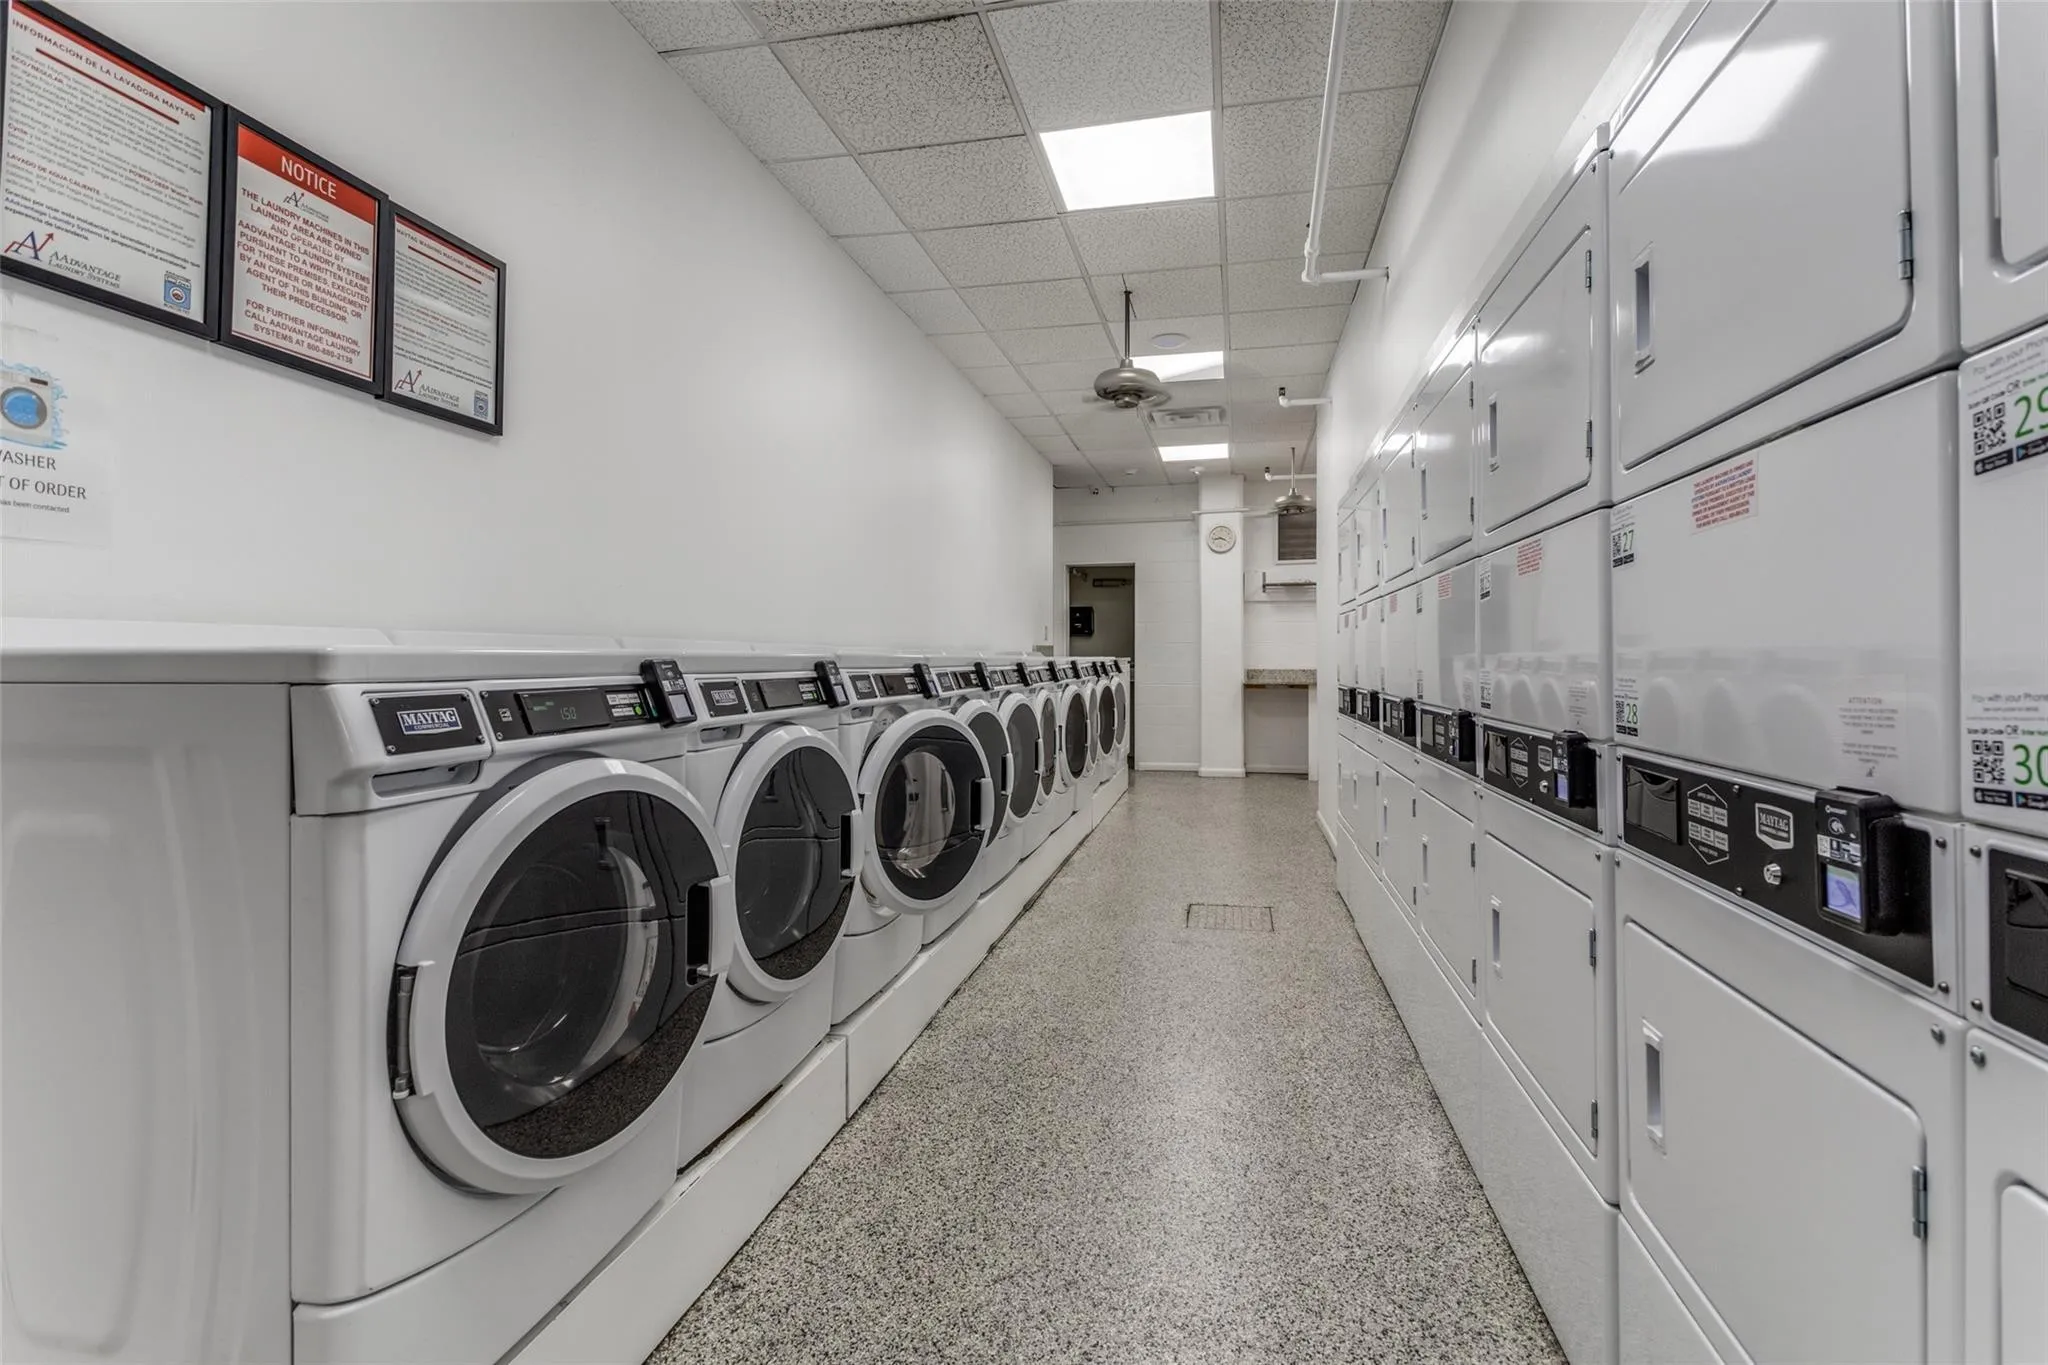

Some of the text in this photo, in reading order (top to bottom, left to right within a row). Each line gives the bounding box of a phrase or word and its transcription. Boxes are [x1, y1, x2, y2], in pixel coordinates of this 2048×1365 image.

[85, 57, 96, 68] DE
[100, 65, 110, 76] LA
[114, 72, 159, 101] LAVADORA
[162, 97, 195, 120] MAYTAG
[281, 154, 336, 200] NOTICE
[241, 187, 258, 203] THE
[261, 196, 300, 222] LAUNDRY
[302, 216, 342, 242] MACHINES
[344, 236, 351, 246] IN
[353, 240, 369, 255] THIS
[251, 203, 290, 228] LAUNDRY
[292, 223, 314, 239] AREA
[316, 234, 332, 248] ARE
[334, 242, 361, 261] OWNED
[238, 218, 369, 284] AADVANTAGE LAUNDRY SYSTEMS
[240, 230, 367, 293] PURSUANT TO A WRITTEN LEASE
[270, 223, 343, 263] AND OPERATED BY
[237, 240, 254, 254] FOR
[258, 249, 284, 267] THESE
[331, 280, 369, 303] EXECUTED
[239, 252, 367, 312] BY AN OWNER OR MANAGEMENT
[262, 283, 286, 299] THEIR
[246, 266, 275, 284] AGENT
[278, 279, 288, 289] OF
[292, 284, 309, 298] THIS
[351, 308, 361, 319] OR
[246, 298, 263, 312] FOR
[266, 305, 304, 327] FURTHER
[244, 309, 360, 357] CALL AADVANTAGE LAUNDRY
[254, 323, 292, 343] SYSTEMS
[295, 337, 304, 347] AT
[9, 477, 30, 491] OF
[34, 480, 86, 500] ORDER
[13, 500, 31, 509] been
[33, 504, 70, 513] contacted
[1623, 530, 1634, 553] 27
[402, 711, 456, 726] MAYTAG
[1625, 703, 1638, 725] 28
[2005, 724, 2019, 736] OR
[1759, 812, 1788, 831] MAYTAG
